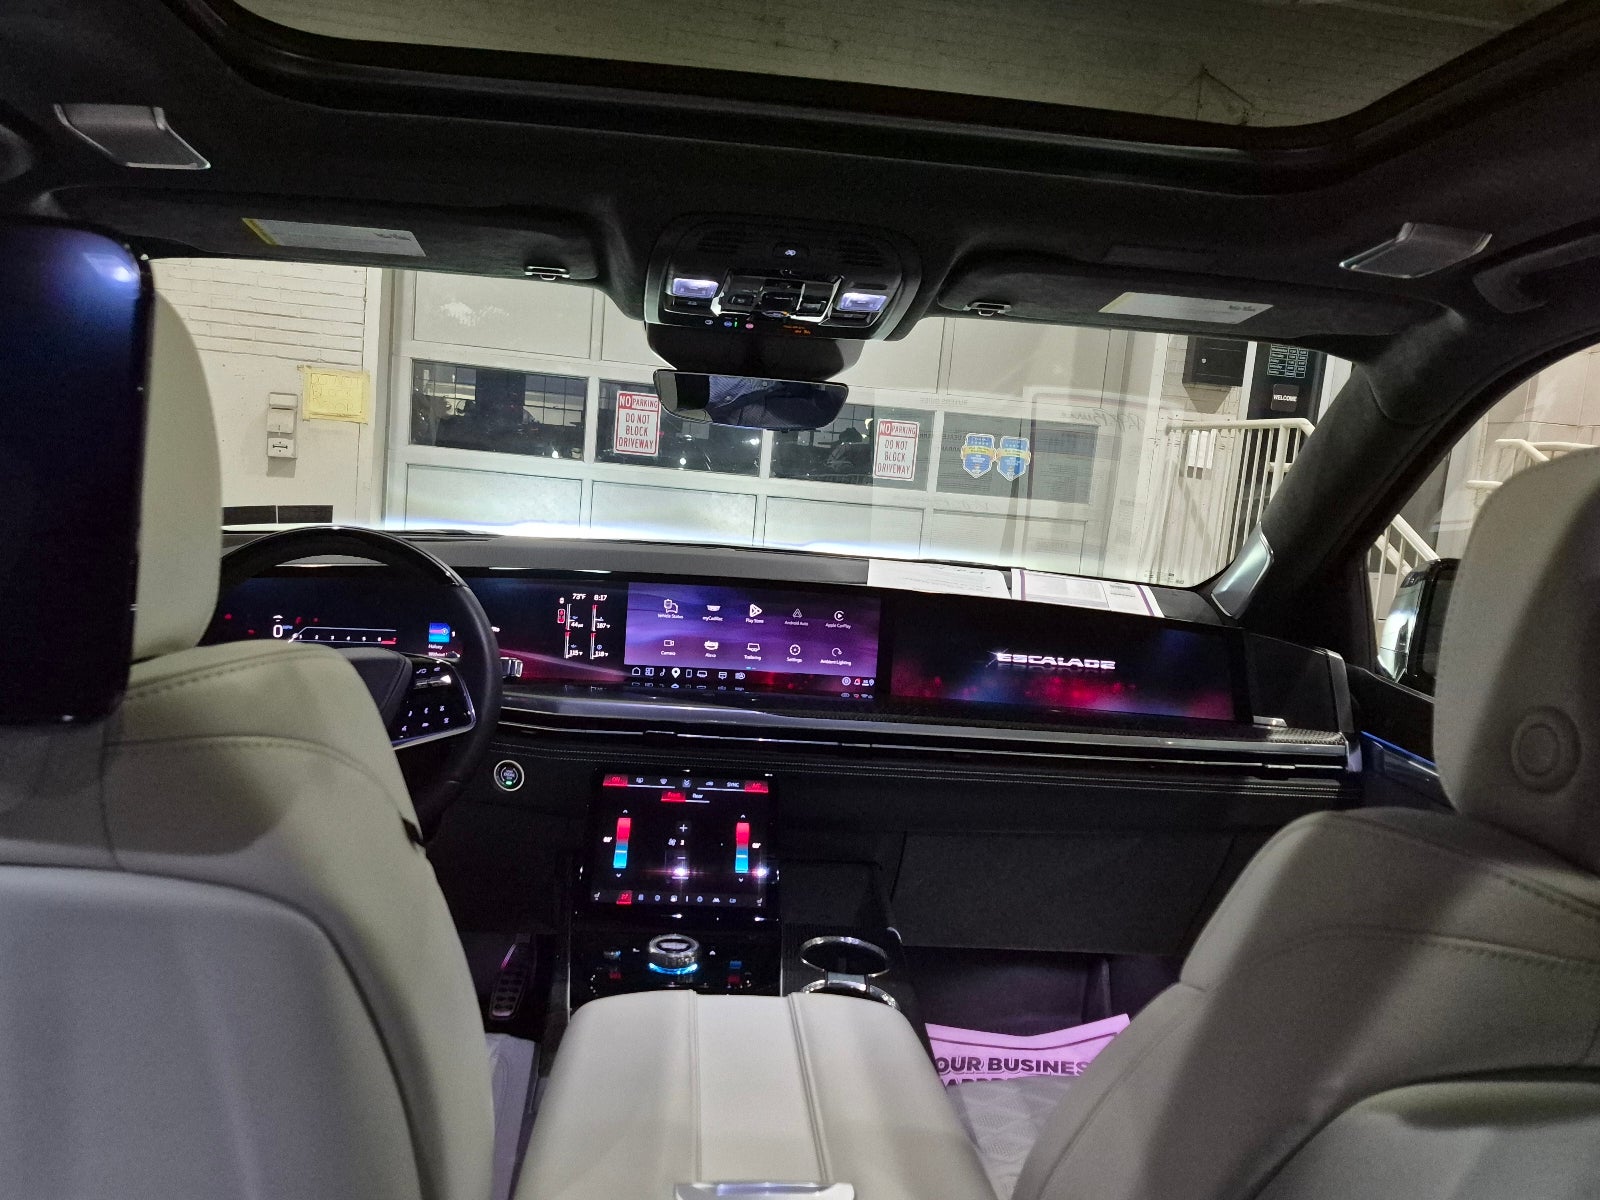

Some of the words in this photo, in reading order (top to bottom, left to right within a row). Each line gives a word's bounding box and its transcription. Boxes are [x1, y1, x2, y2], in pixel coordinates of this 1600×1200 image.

[620, 396, 631, 407] NO
[633, 398, 657, 408] PARKING
[1273, 394, 1297, 402] WELCOME
[626, 413, 635, 423] DO
[637, 414, 650, 424] NOT
[626, 425, 648, 436] BLOCK
[880, 423, 891, 433] NO
[893, 425, 916, 434] PARKING
[619, 437, 653, 449] DRIVEWAY
[885, 440, 893, 449] DO
[896, 441, 908, 450] NOT
[885, 451, 905, 462] BLOCK
[878, 463, 910, 474] DRIVEWAY
[273, 625, 283, 637] 0
[997, 653, 1115, 669] ESCALADE
